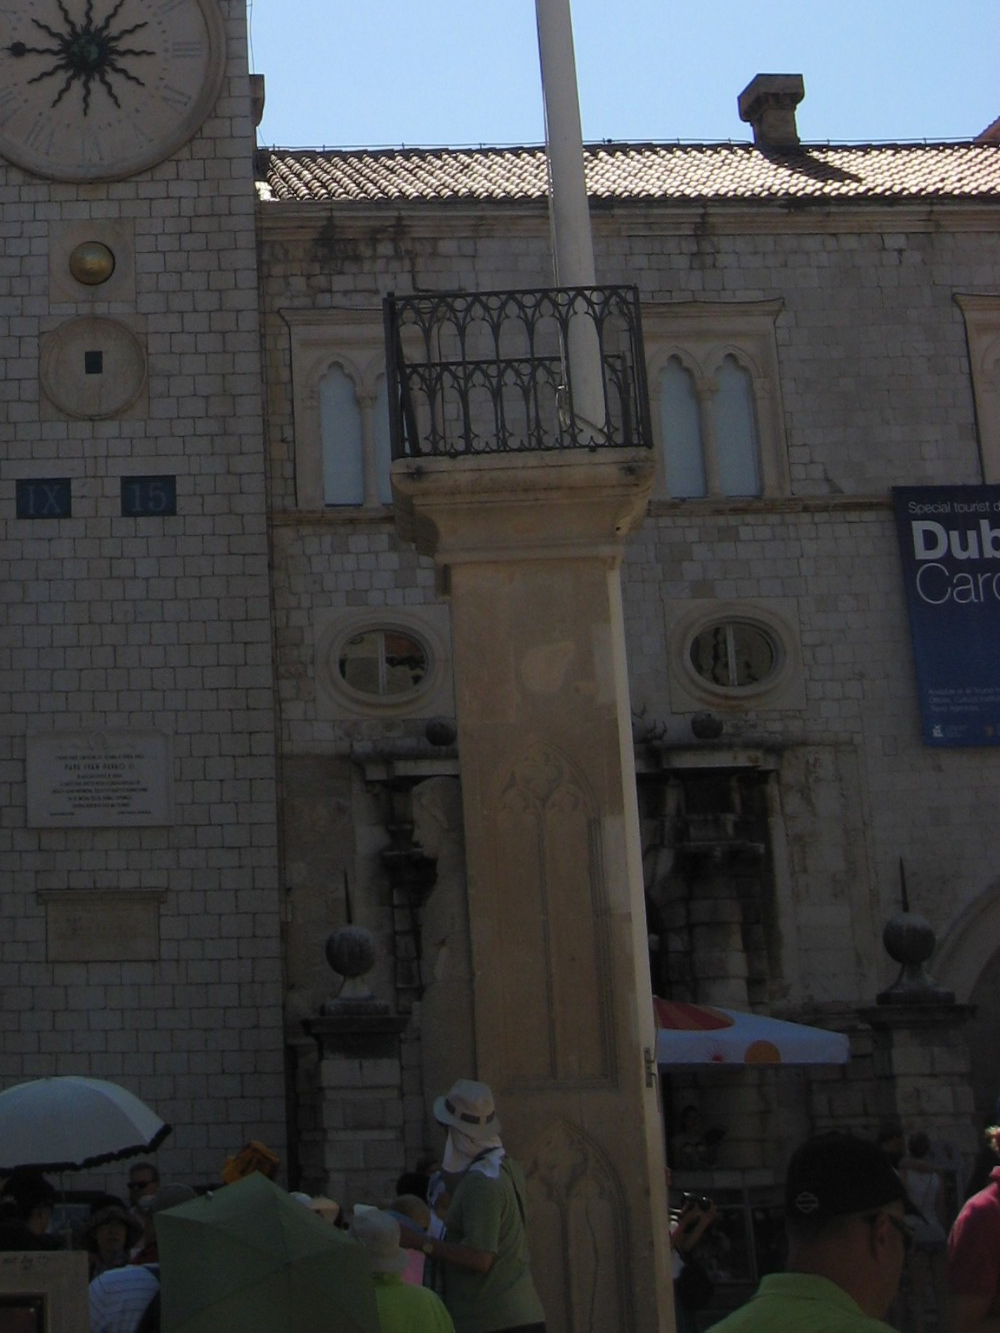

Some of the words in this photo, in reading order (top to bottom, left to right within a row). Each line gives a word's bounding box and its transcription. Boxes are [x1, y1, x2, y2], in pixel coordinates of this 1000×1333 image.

[27, 485, 62, 515] IX
[130, 482, 168, 512] 15
[907, 501, 951, 515] Special
[954, 501, 990, 513] tourist
